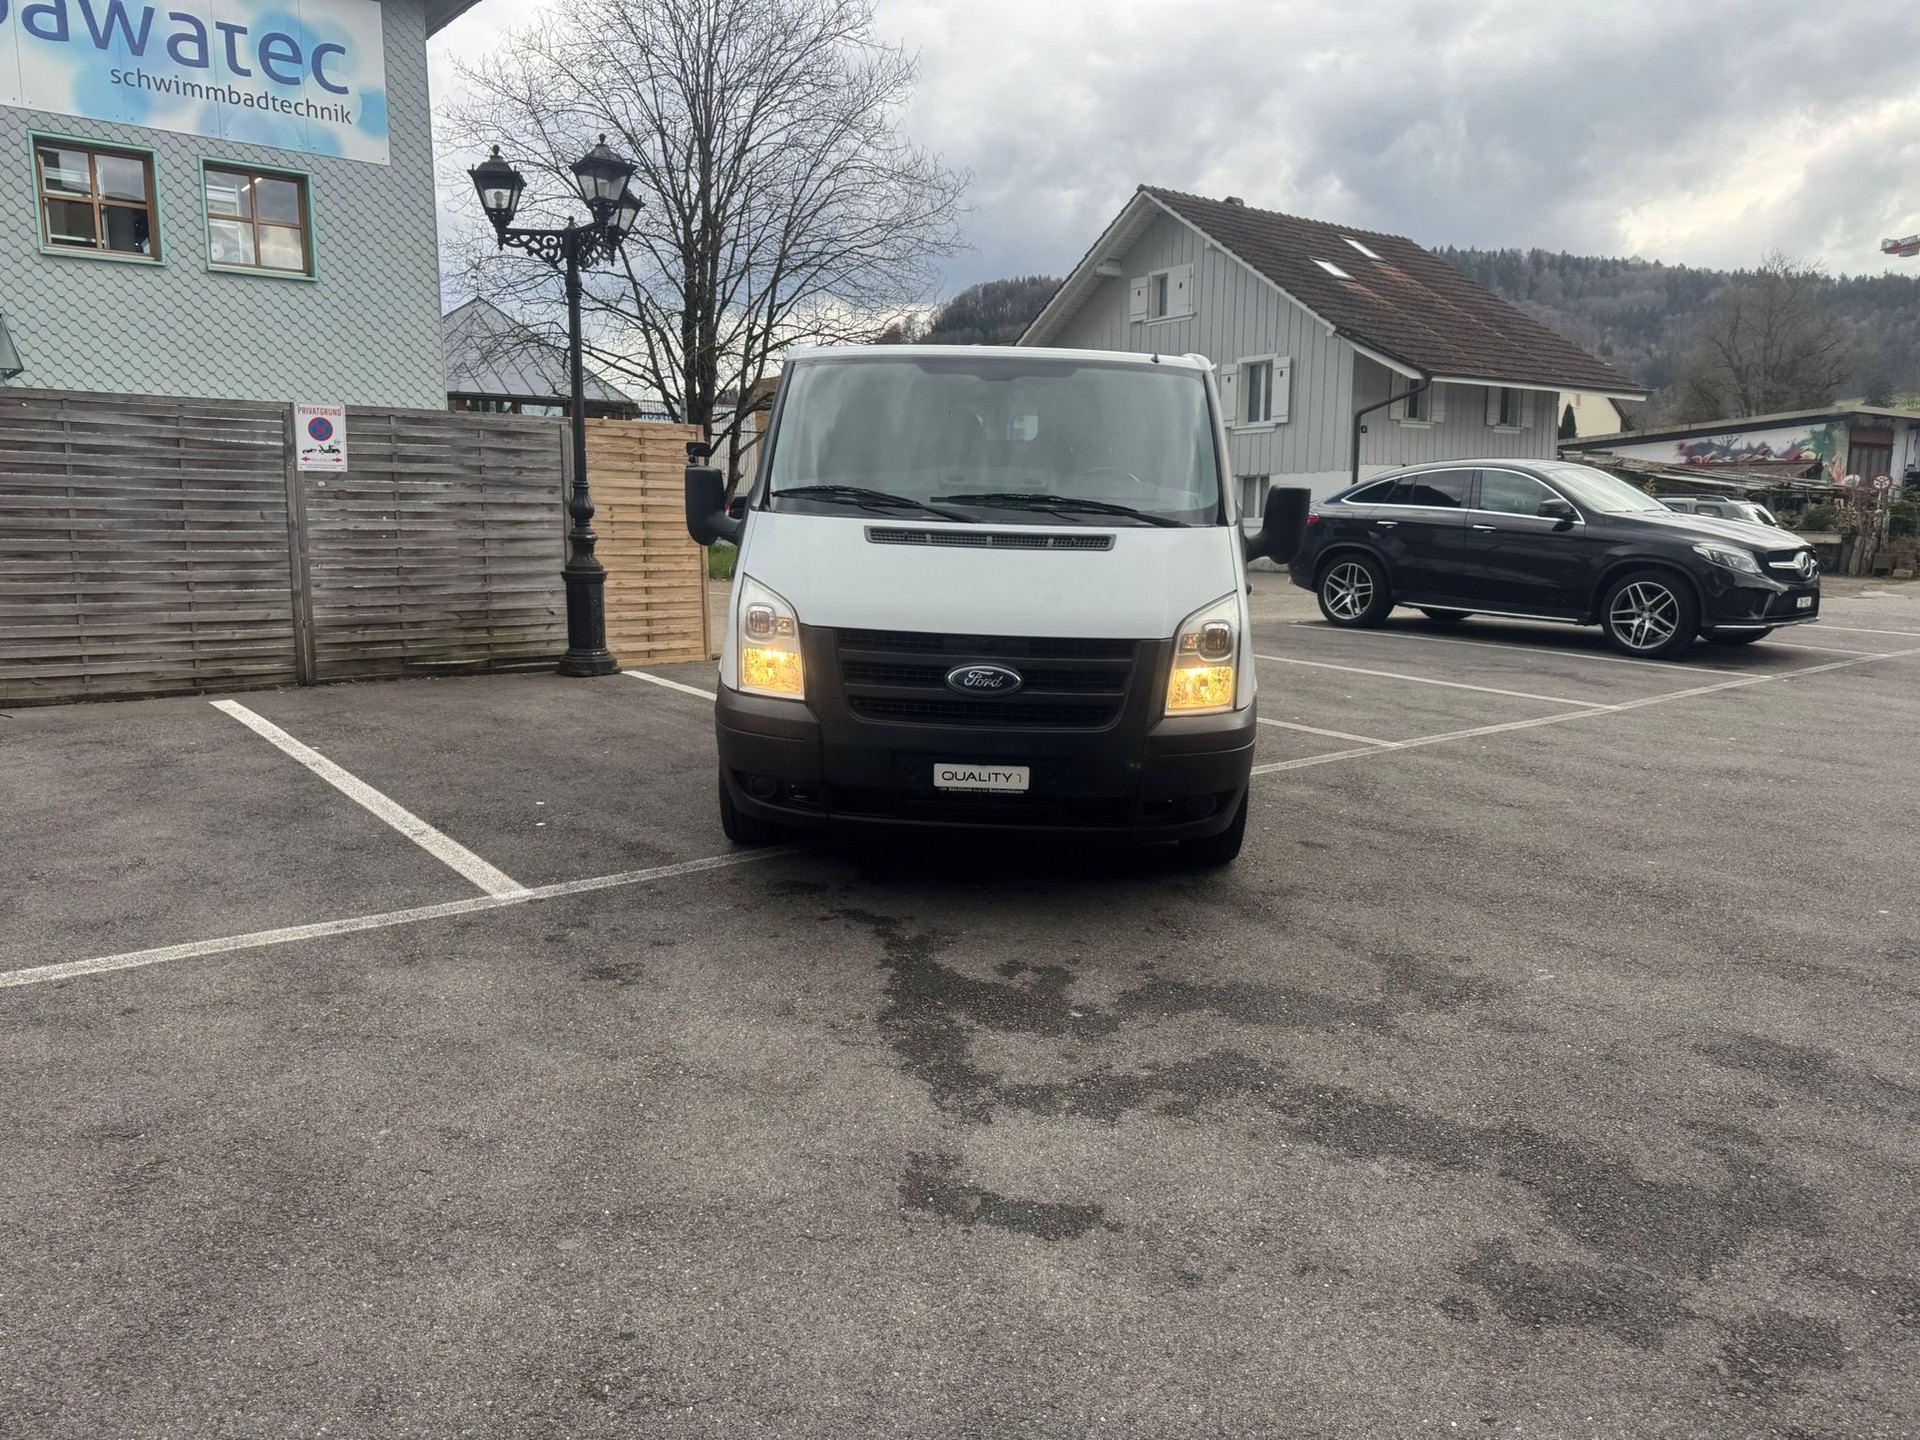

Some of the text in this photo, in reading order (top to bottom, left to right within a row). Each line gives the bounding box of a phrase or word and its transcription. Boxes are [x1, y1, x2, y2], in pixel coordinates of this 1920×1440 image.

[0, 0, 350, 95] awatec
[109, 67, 353, 125] schwimmbadtechnik
[297, 406, 342, 417] PRIVATGRUND
[963, 669, 1004, 688] Ford
[941, 770, 1013, 783] QUALITY
